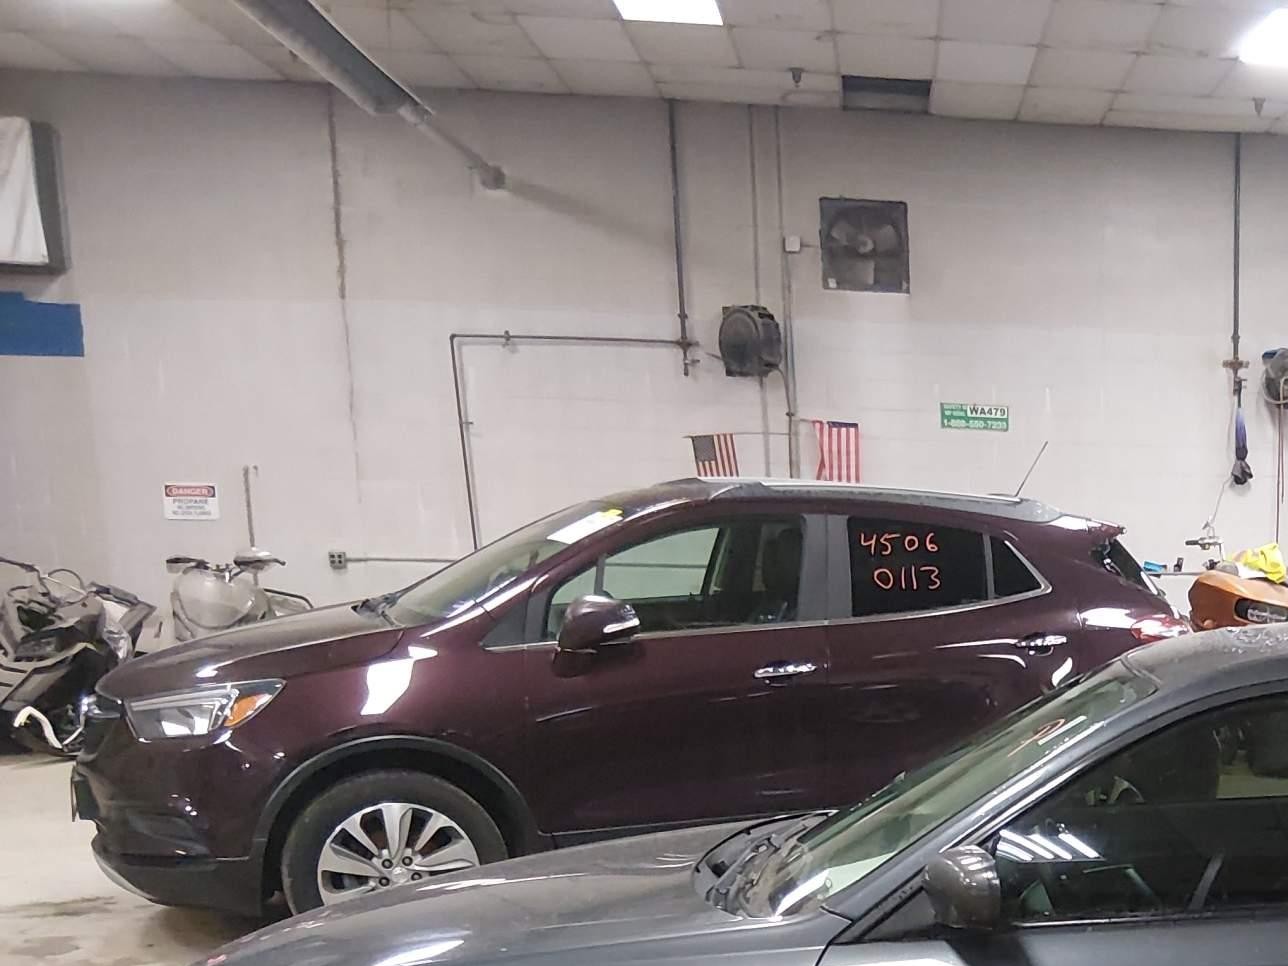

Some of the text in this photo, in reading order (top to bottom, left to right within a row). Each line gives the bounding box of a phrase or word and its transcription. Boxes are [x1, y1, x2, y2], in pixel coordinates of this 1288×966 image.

[969, 406, 1006, 416] WA479
[172, 487, 209, 495] DANGER
[860, 532, 939, 555] 4506
[873, 565, 941, 590] 0113
